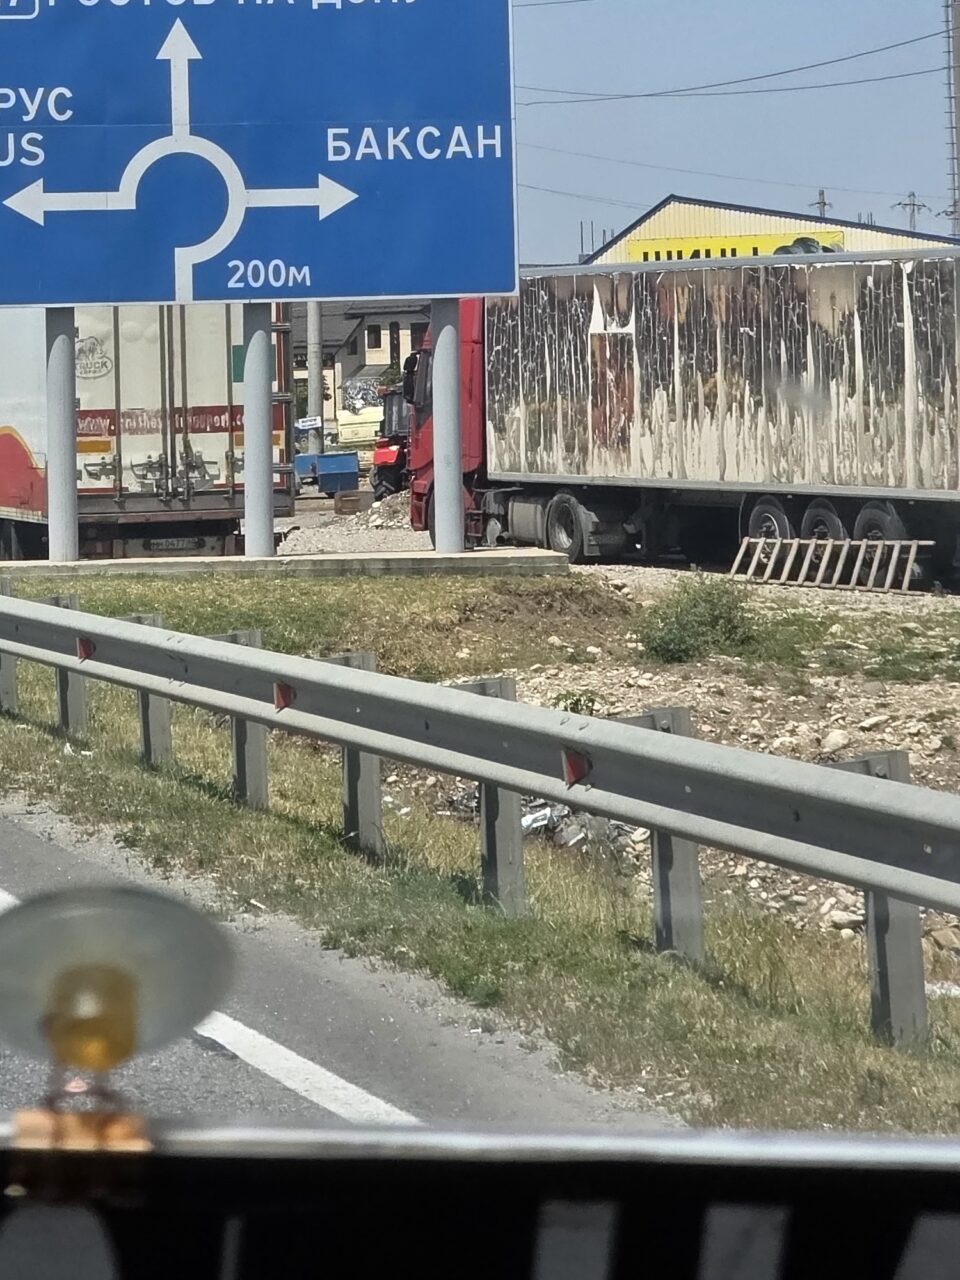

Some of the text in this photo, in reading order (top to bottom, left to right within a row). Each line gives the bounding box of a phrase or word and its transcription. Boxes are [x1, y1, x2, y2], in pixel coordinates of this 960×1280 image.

[326, 125, 502, 161] БАКСАН
[227, 259, 311, 288] 200м
[76, 360, 108, 370] RUCK
